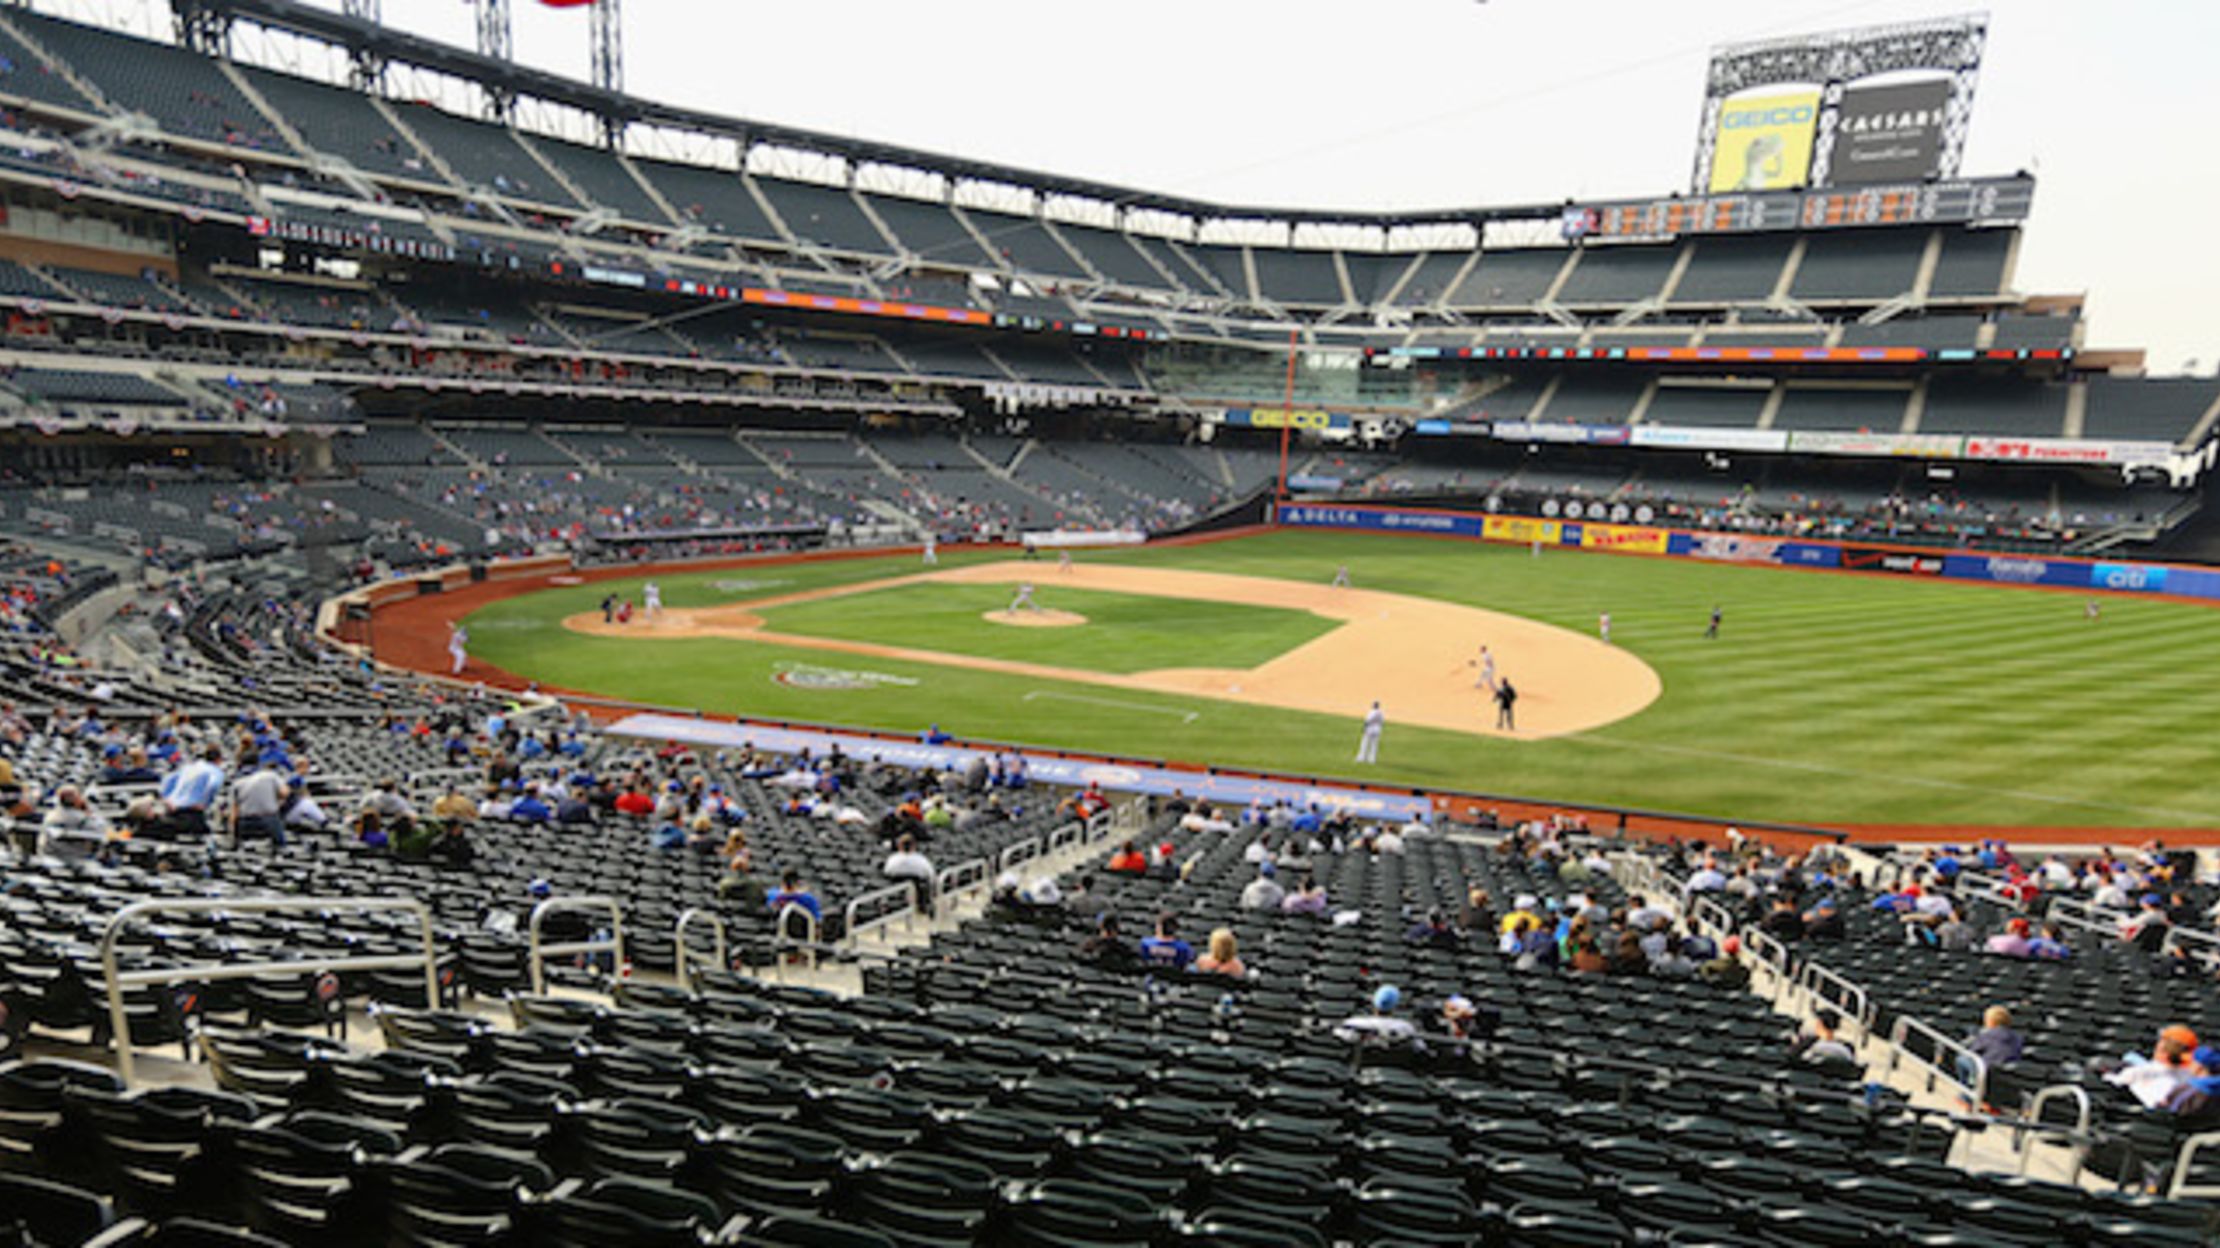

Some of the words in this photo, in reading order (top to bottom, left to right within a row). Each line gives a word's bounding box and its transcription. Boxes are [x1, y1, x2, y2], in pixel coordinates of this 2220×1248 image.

[1724, 105, 1813, 129] GEICO
[1839, 108, 1944, 133] CAESARS
[1251, 408, 1330, 430] GEICO
[2106, 569, 2147, 589] citi
